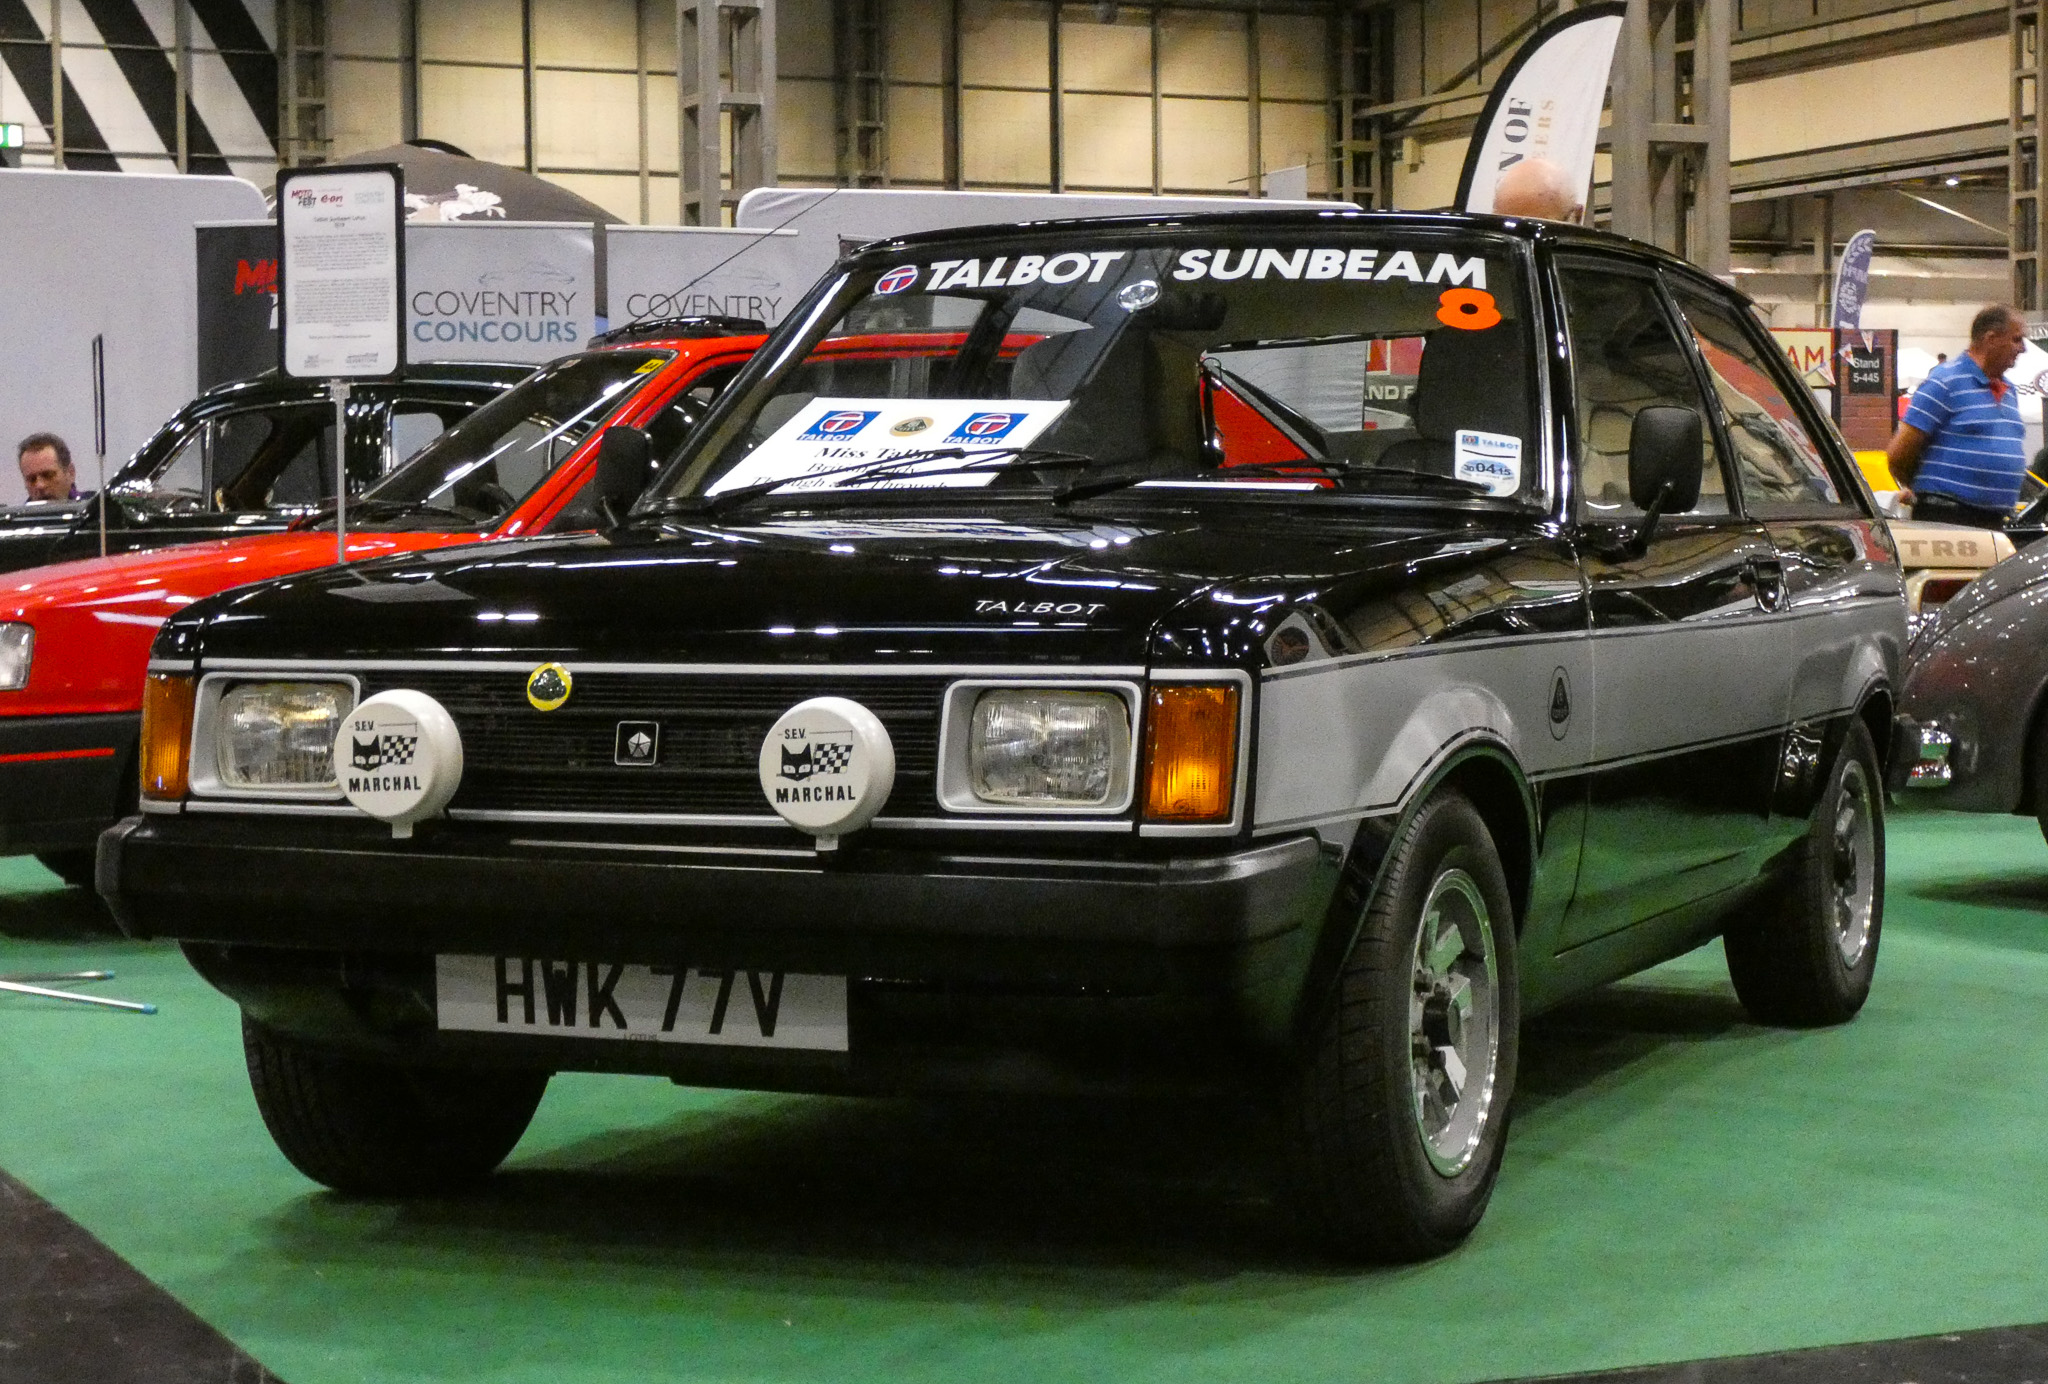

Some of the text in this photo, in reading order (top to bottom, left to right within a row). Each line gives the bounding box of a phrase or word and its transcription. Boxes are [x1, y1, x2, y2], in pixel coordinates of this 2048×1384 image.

[1503, 97, 1533, 143] OF
[924, 248, 1487, 291] TALBOT SUNBEAM
[412, 290, 577, 317] COVENTRY
[626, 293, 782, 321] COVENTRY
[413, 321, 577, 343] CONCOURS
[1853, 357, 1880, 369] Stand
[1852, 372, 1880, 384] 5-445
[1364, 385, 1400, 400] ND
[800, 433, 856, 442] TALBOT
[944, 436, 1002, 445] TALBOT
[1482, 439, 1519, 450] TALBOT
[815, 447, 868, 459] Miss
[1476, 463, 1496, 474] 04
[1899, 539, 1979, 558] TR8
[975, 600, 1106, 615] TALBOT
[349, 776, 422, 793] MARCHAL
[776, 785, 856, 803] MARCHAL
[494, 957, 628, 1029] HWK
